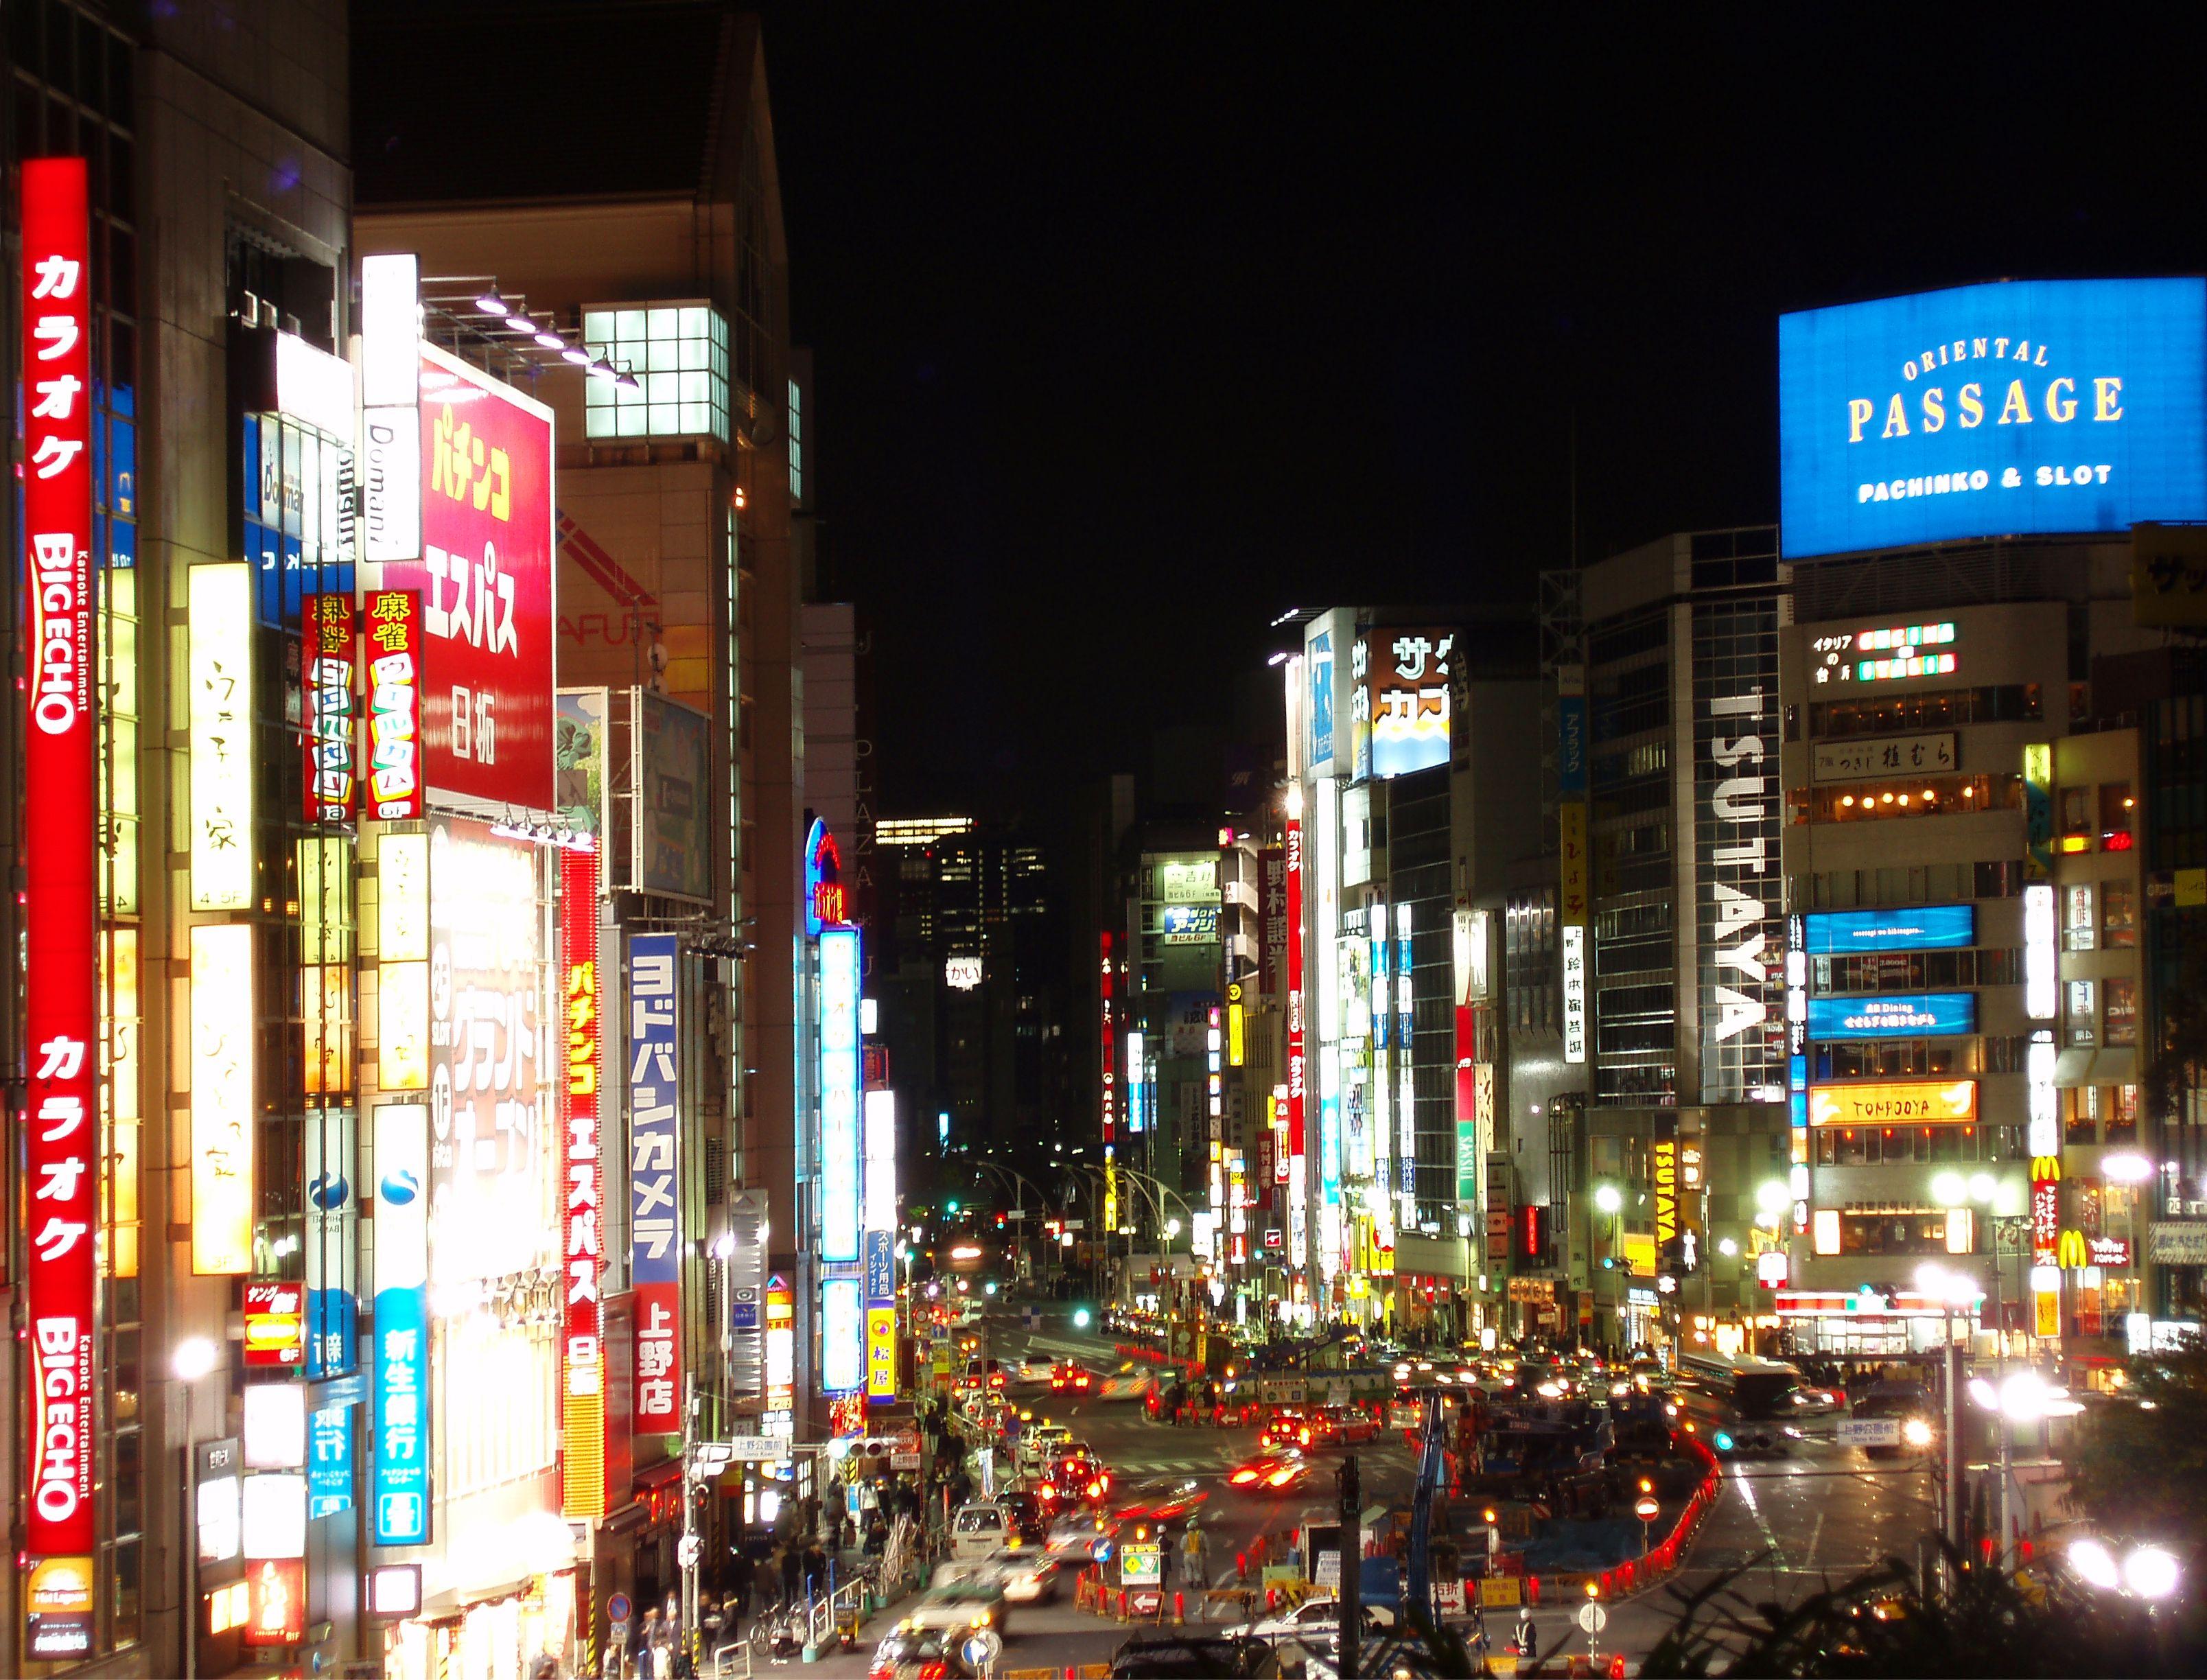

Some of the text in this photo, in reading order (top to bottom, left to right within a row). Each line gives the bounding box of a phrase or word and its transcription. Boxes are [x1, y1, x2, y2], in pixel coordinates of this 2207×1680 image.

[32, 255, 82, 479] カラオケ
[1848, 377, 2123, 443] PASSAGE
[1903, 338, 2048, 380] ORIENTAL
[370, 424, 393, 543] Domani
[432, 402, 510, 522] パチンコ
[1858, 465, 2112, 503] PACHINKO & SLOT
[34, 533, 75, 734] BIG ECHO
[76, 550, 89, 712] Karaoke Entertainment
[372, 594, 410, 651] 麻雀
[424, 541, 517, 659] エスパス
[1814, 635, 1852, 651] イタリア
[1827, 653, 1839, 665] の
[452, 685, 495, 765] 日拓
[1287, 830, 1299, 872] カラオケ
[1710, 686, 1767, 1042] TSUTAYA
[454, 985, 533, 1093] グランド
[568, 961, 596, 1095] パチンコ
[36, 1036, 86, 1261] カラオケ
[631, 955, 677, 1260] ヨドバシカメラ
[567, 1119, 598, 1305] エスパス
[1655, 1142, 1675, 1244] TSUTAYA
[878, 1230, 889, 1295] スポーツ用品
[386, 1329, 417, 1460] 新生銀行
[638, 1301, 674, 1415] 上野店
[873, 1346, 889, 1386] 松屋
[36, 1317, 77, 1523] BIG ECHO
[80, 1335, 91, 1500] Karaoke Entertainment
[738, 1440, 782, 1451] 上野公園前
